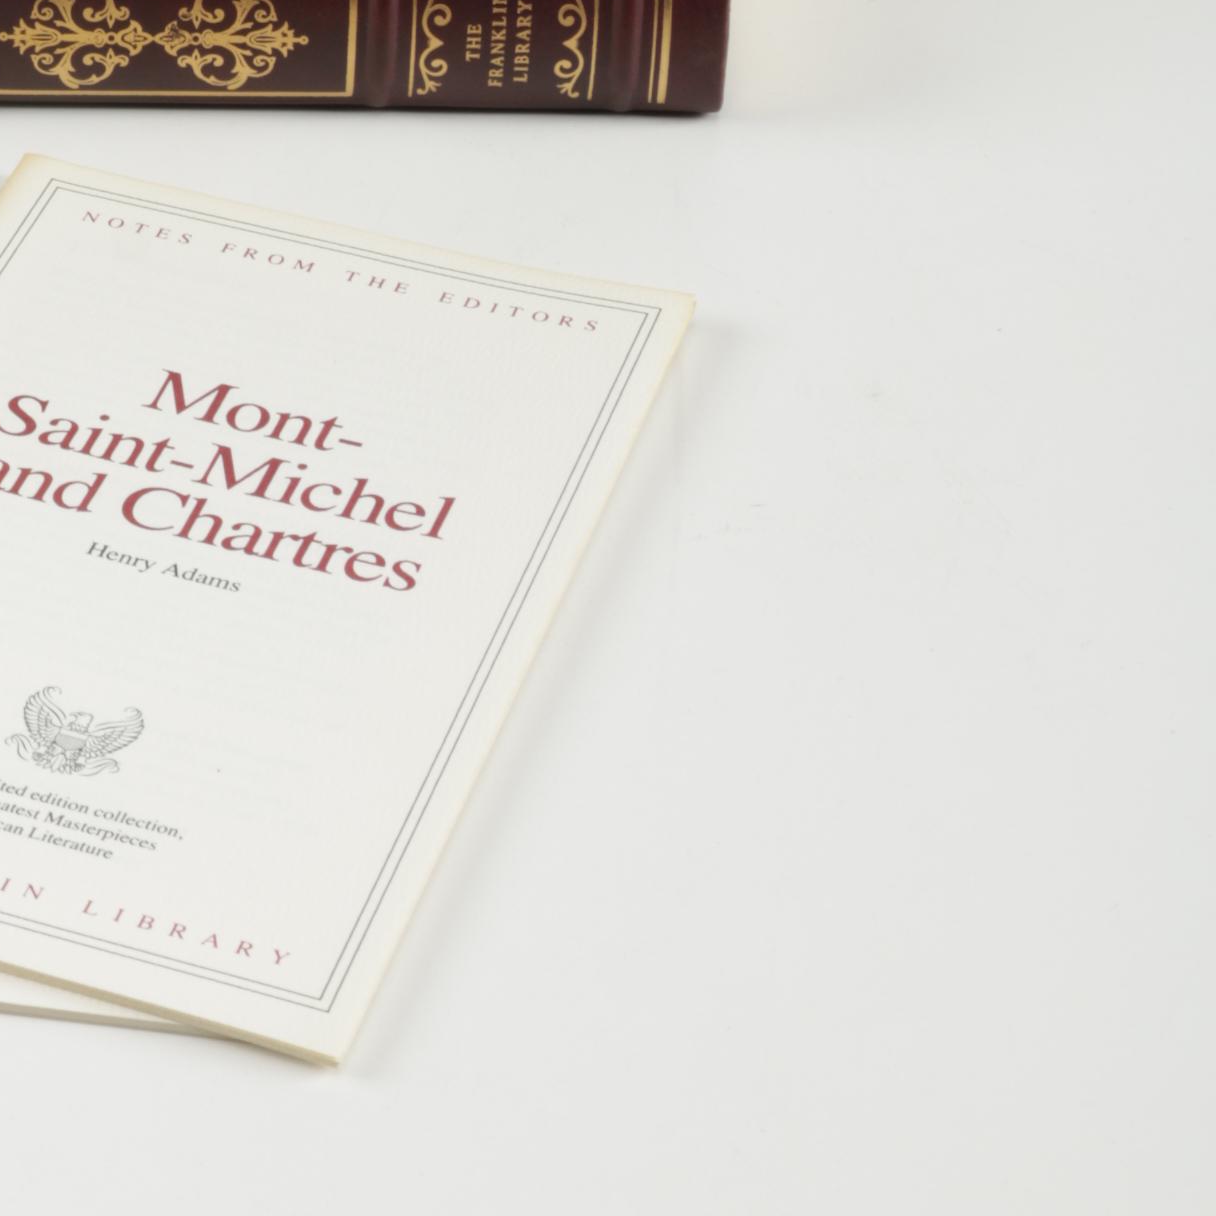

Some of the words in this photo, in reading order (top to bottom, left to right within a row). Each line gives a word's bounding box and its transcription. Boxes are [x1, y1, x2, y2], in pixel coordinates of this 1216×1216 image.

[466, 23, 483, 62] THE
[513, 0, 534, 83] LIBRARY
[82, 210, 193, 245] NOTES
[221, 242, 316, 273] FROM
[345, 270, 411, 294] THE
[438, 291, 599, 332] EDITORS
[141, 369, 364, 451] Mont-
[85, 540, 157, 573] Henry
[161, 562, 242, 594] Adams
[121, 486, 423, 592] Chartres
[29, 792, 90, 815] edition
[43, 811, 158, 851] Masterpieces
[28, 826, 114, 860] Literature
[82, 899, 291, 966] LIBRARY
